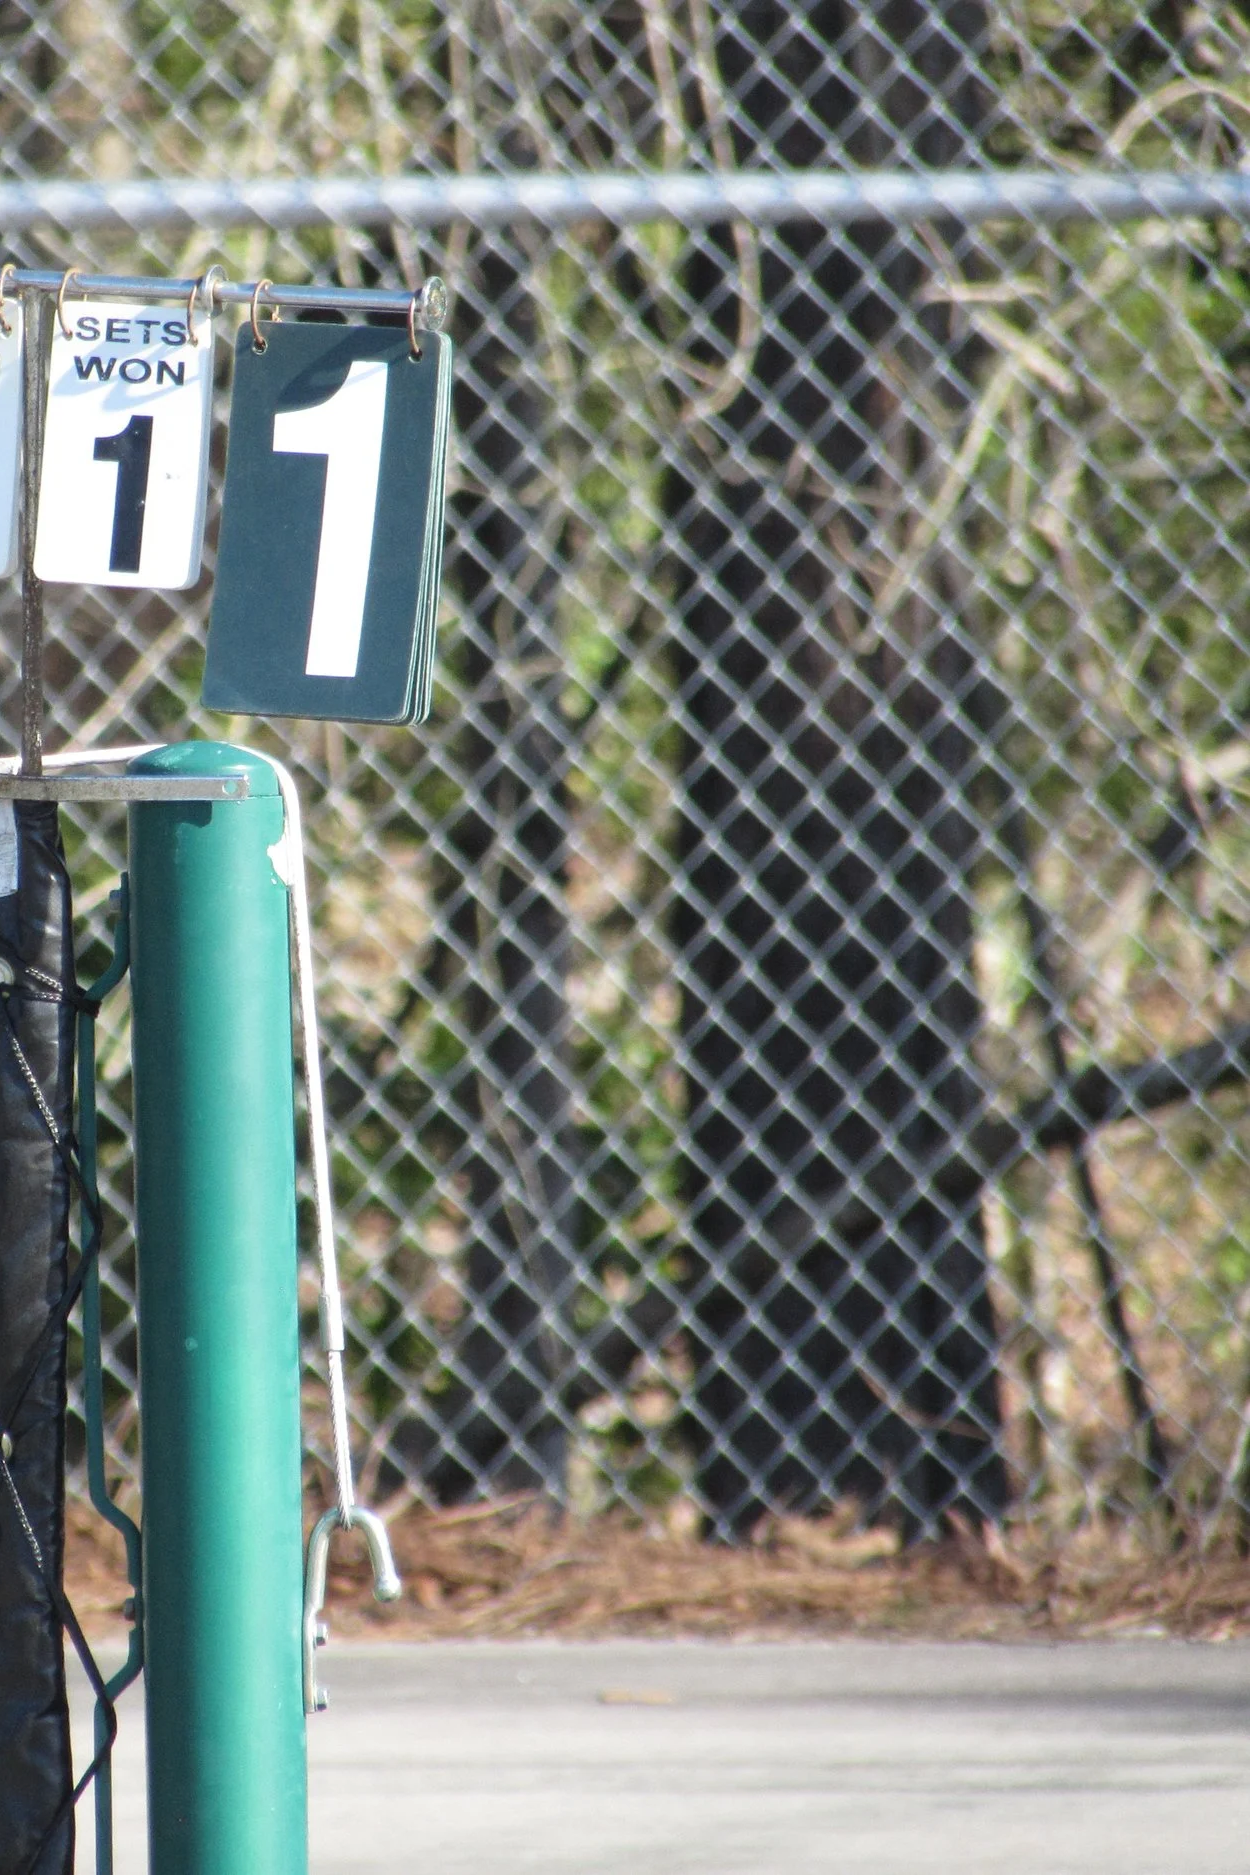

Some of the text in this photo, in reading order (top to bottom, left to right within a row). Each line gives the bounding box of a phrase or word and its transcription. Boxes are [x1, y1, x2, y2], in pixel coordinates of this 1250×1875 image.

[73, 355, 185, 386] WON
[75, 316, 187, 346] SETS
[93, 414, 154, 574] 1
[272, 360, 389, 678] 1
